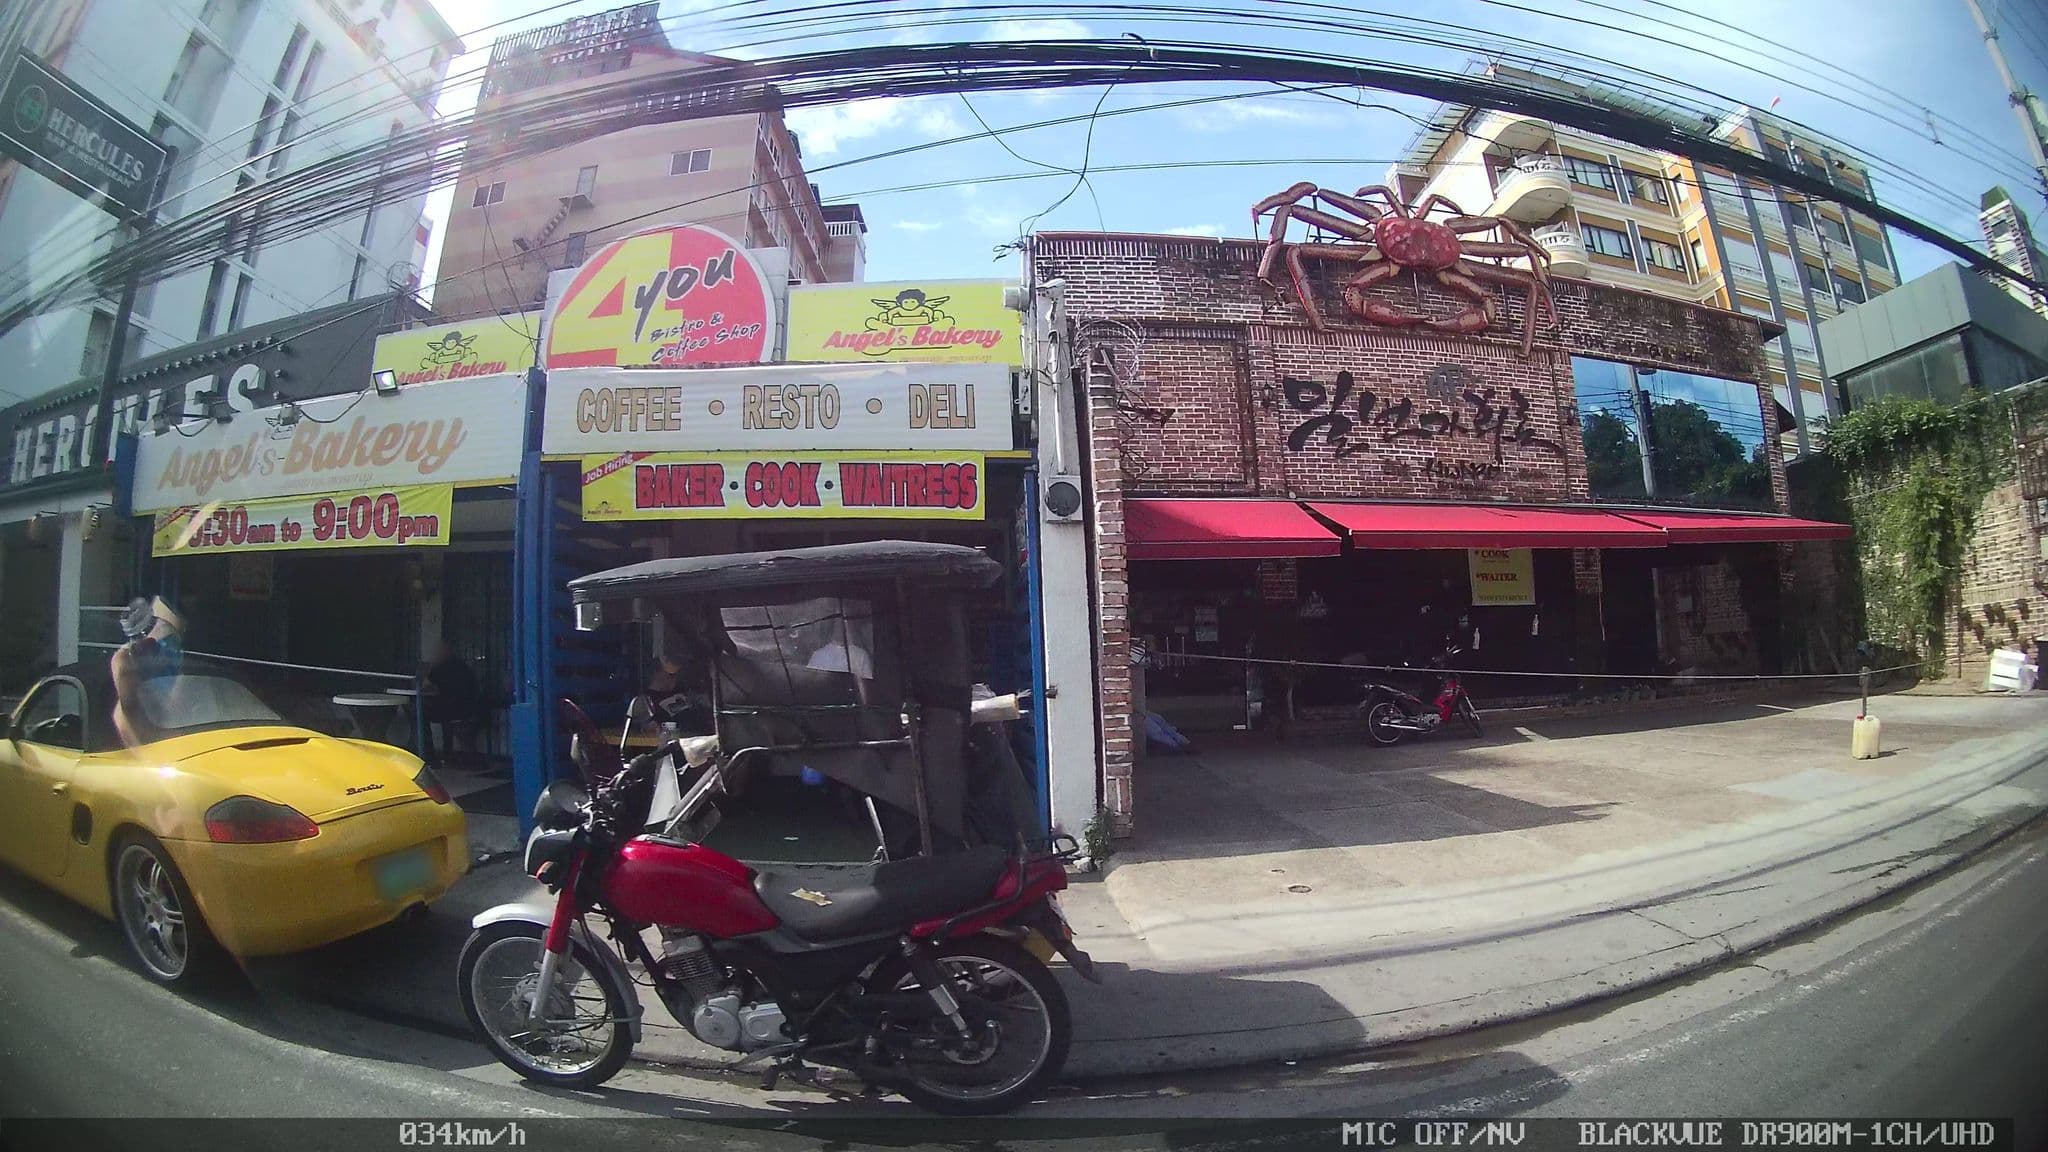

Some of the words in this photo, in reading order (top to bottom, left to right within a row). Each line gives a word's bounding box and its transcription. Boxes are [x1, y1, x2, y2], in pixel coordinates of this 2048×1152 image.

[47, 107, 144, 181] HERCULES
[551, 232, 683, 365] 4
[634, 250, 737, 343] you
[650, 320, 704, 343] Bistro
[710, 312, 724, 326] &
[651, 337, 710, 363] Coffee
[715, 322, 761, 345] Shop
[823, 328, 907, 351] Angel's
[911, 326, 1003, 348] Bakery
[576, 386, 683, 433] COFFEE
[742, 384, 841, 430] RESTO
[909, 383, 977, 429] DELI
[157, 431, 275, 496] Angel's
[282, 416, 468, 475] Bakery
[585, 467, 602, 484] Job
[604, 453, 634, 479] Hiring
[635, 463, 726, 508] BAKER
[745, 461, 823, 508] COOK
[837, 461, 978, 510] WAITRESS
[181, 505, 275, 547] :30am
[281, 517, 302, 543] to
[312, 492, 439, 545] 9:00pm
